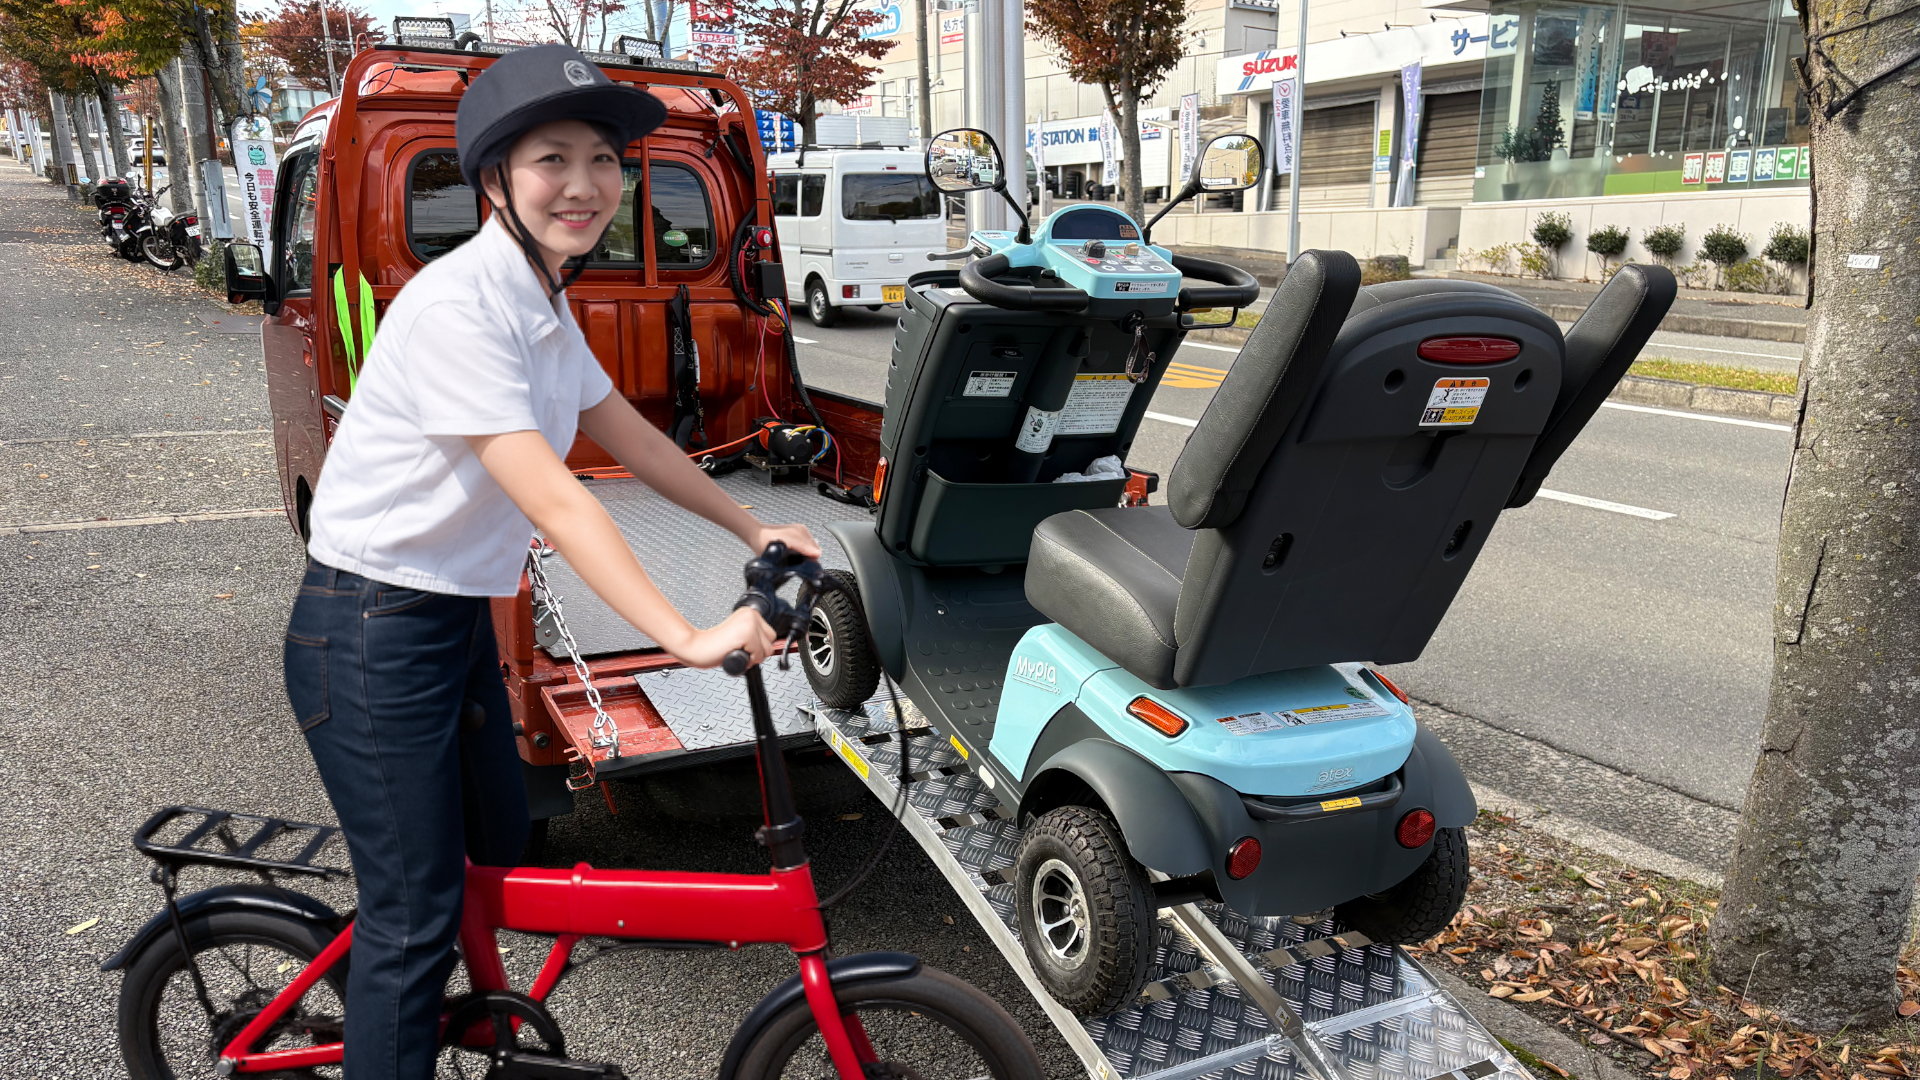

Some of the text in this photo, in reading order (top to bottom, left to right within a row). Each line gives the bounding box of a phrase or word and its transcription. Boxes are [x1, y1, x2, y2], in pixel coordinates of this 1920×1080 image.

[1243, 54, 1297, 76] SUZUK
[762, 121, 789, 129] アト
[1041, 127, 1084, 147] STATION
[244, 172, 265, 248] 今日も安全運転で
[1015, 655, 1057, 684] Mypia
[1318, 765, 1354, 783] atex
